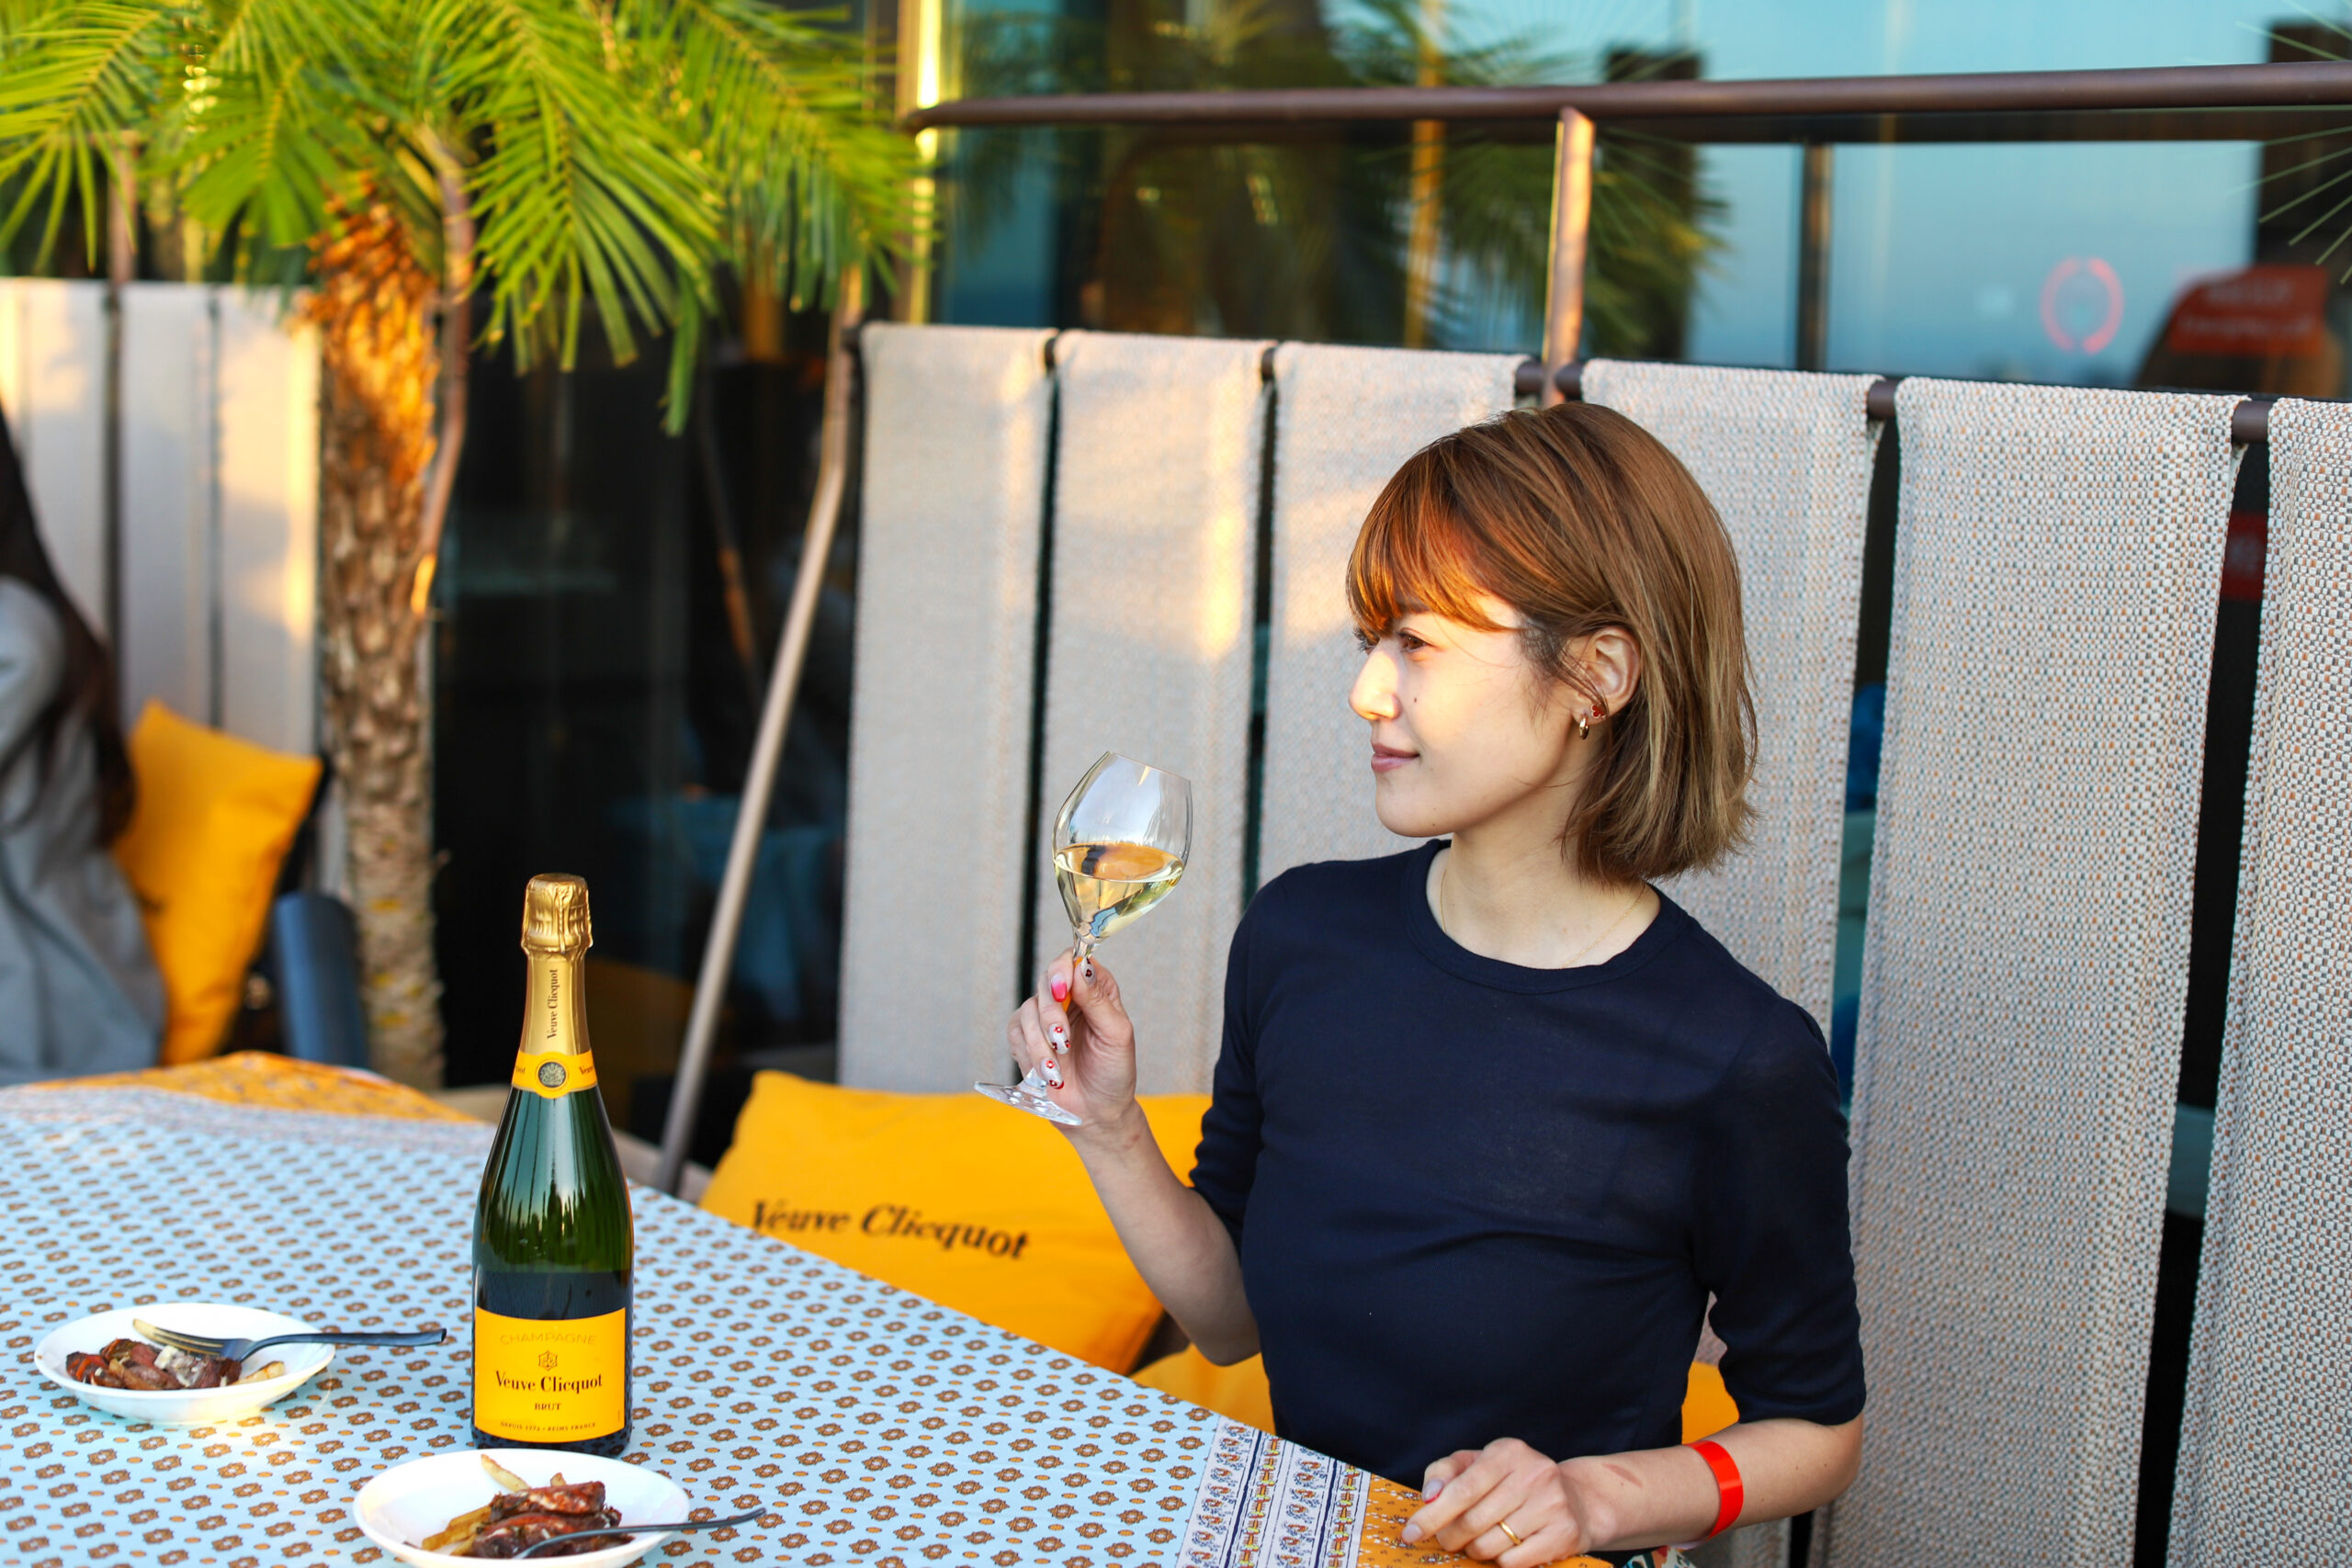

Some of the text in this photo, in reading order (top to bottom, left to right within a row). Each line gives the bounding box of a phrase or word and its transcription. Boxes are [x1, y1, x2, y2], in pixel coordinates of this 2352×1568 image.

[547, 969, 561, 1040] Veuve Clicquot
[751, 1199, 1030, 1260] Veuve Clicquot
[500, 1332, 596, 1346] CHAMPAGNE
[495, 1370, 604, 1394] Veuve Clicquot
[534, 1403, 561, 1411] BRUT
